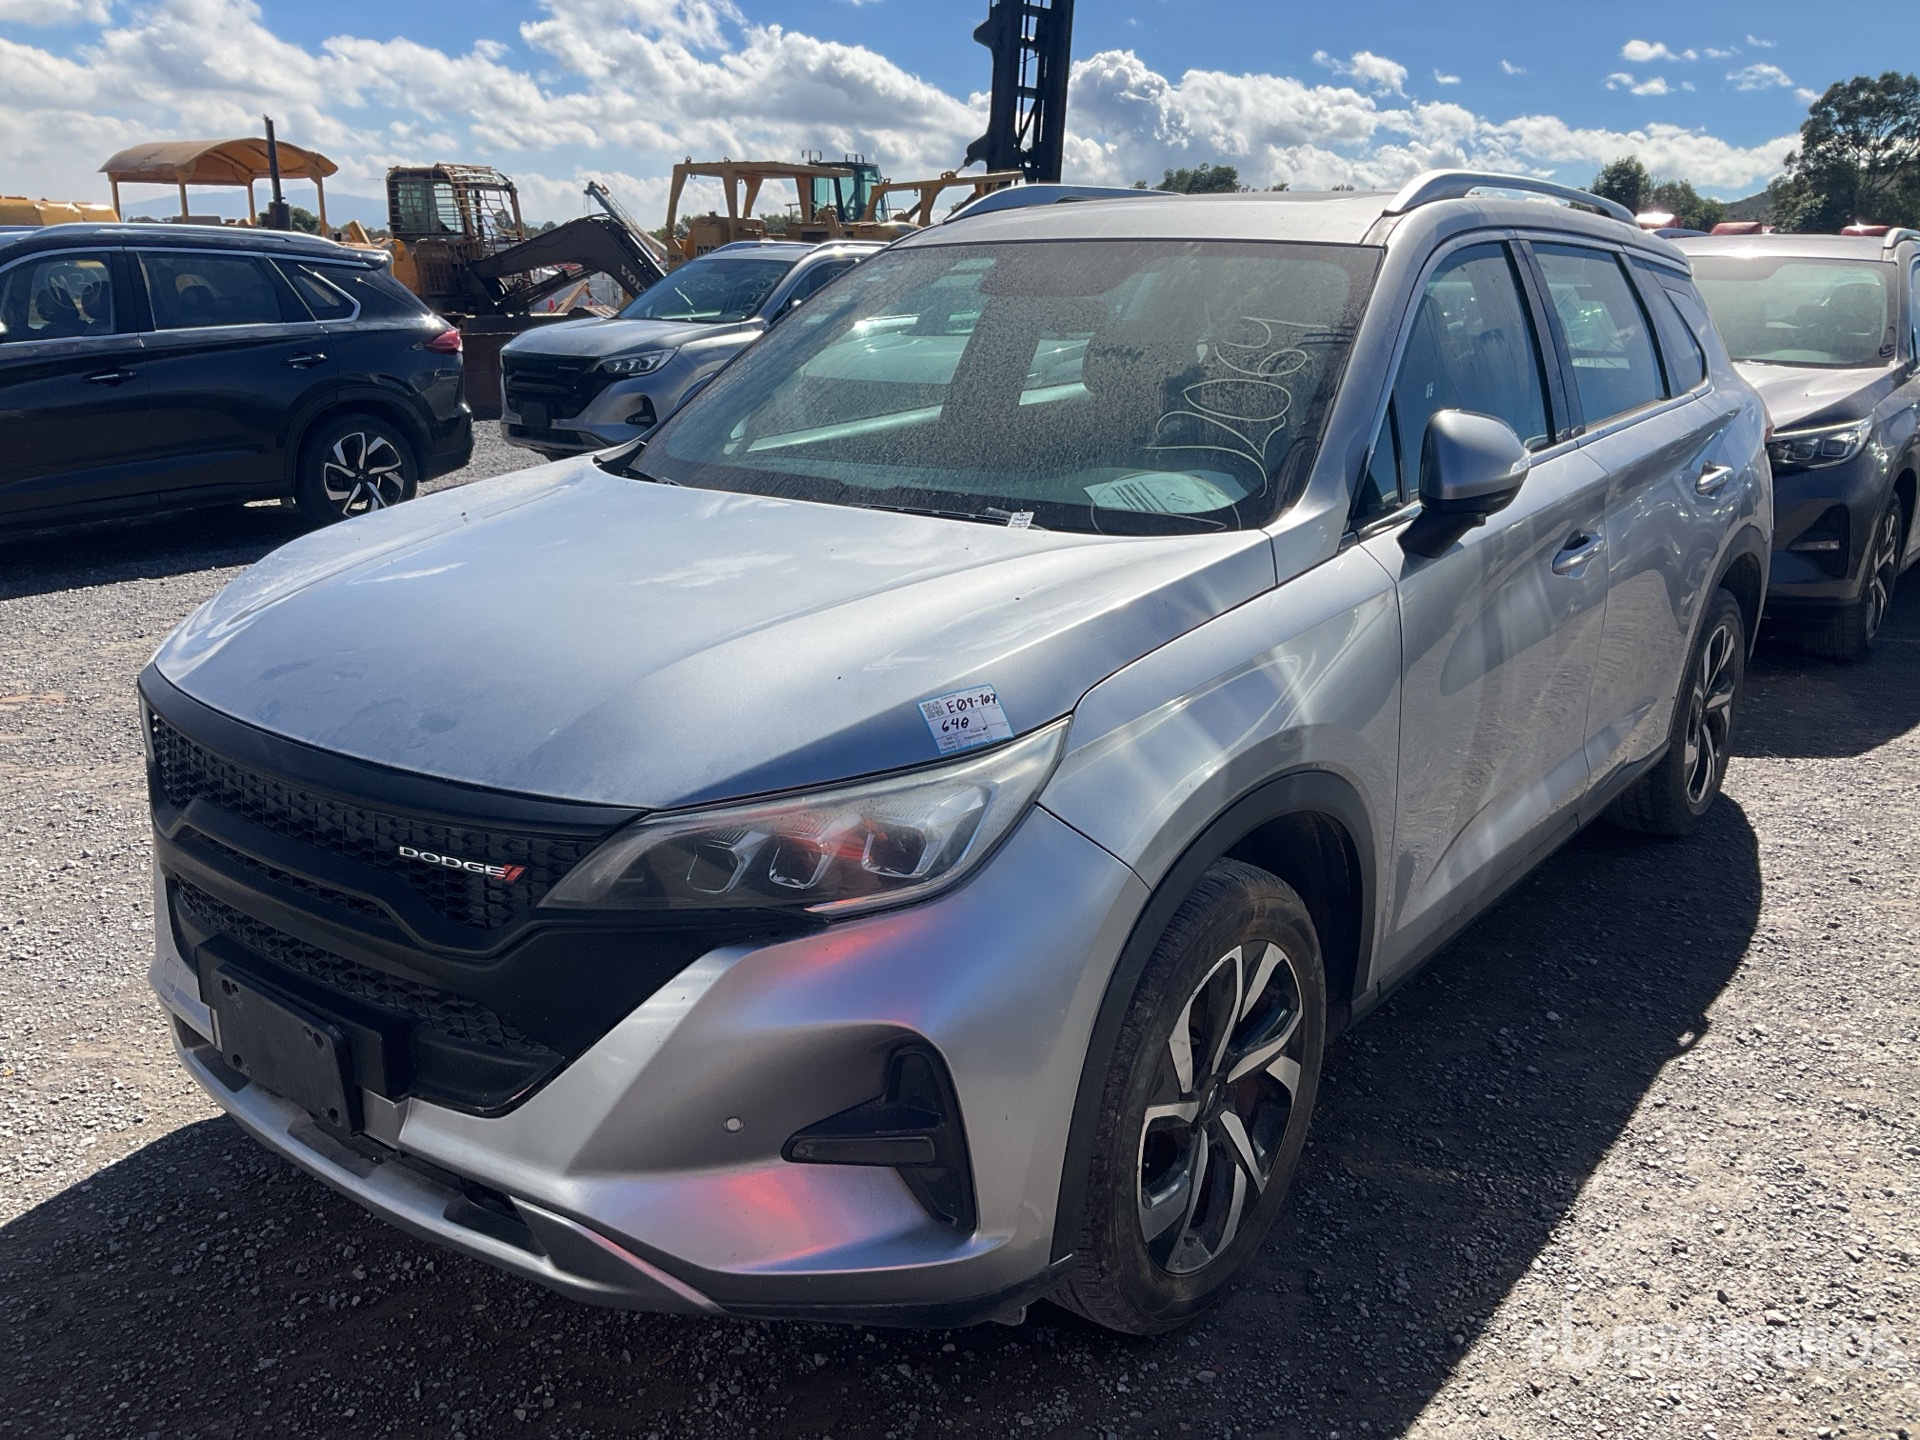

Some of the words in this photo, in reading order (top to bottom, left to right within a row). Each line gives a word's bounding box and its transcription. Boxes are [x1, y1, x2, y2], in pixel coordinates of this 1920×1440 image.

[621, 264, 646, 292] VOL
[942, 717, 969, 732] 640
[399, 845, 507, 878] DODGE
